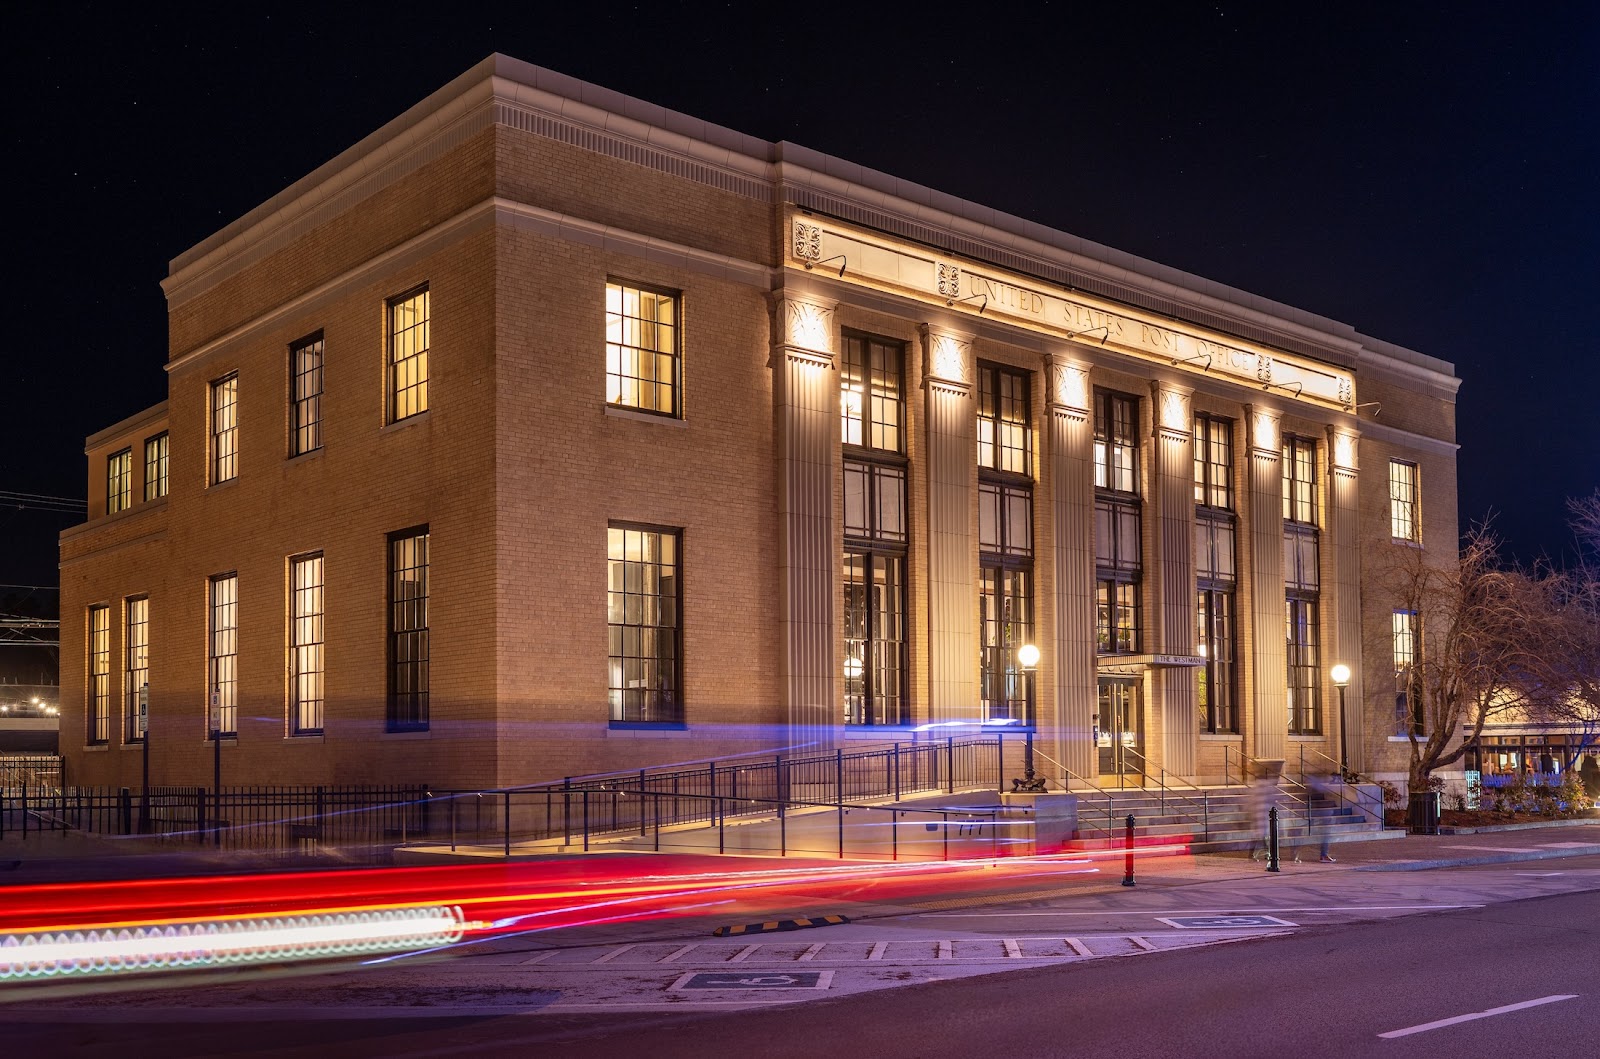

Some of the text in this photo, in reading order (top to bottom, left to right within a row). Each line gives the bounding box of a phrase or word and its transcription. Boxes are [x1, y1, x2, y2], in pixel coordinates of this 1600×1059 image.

[970, 275, 1249, 371] UNITED STATES POST OFFICE
[1160, 655, 1201, 664] THE WESTMAN
